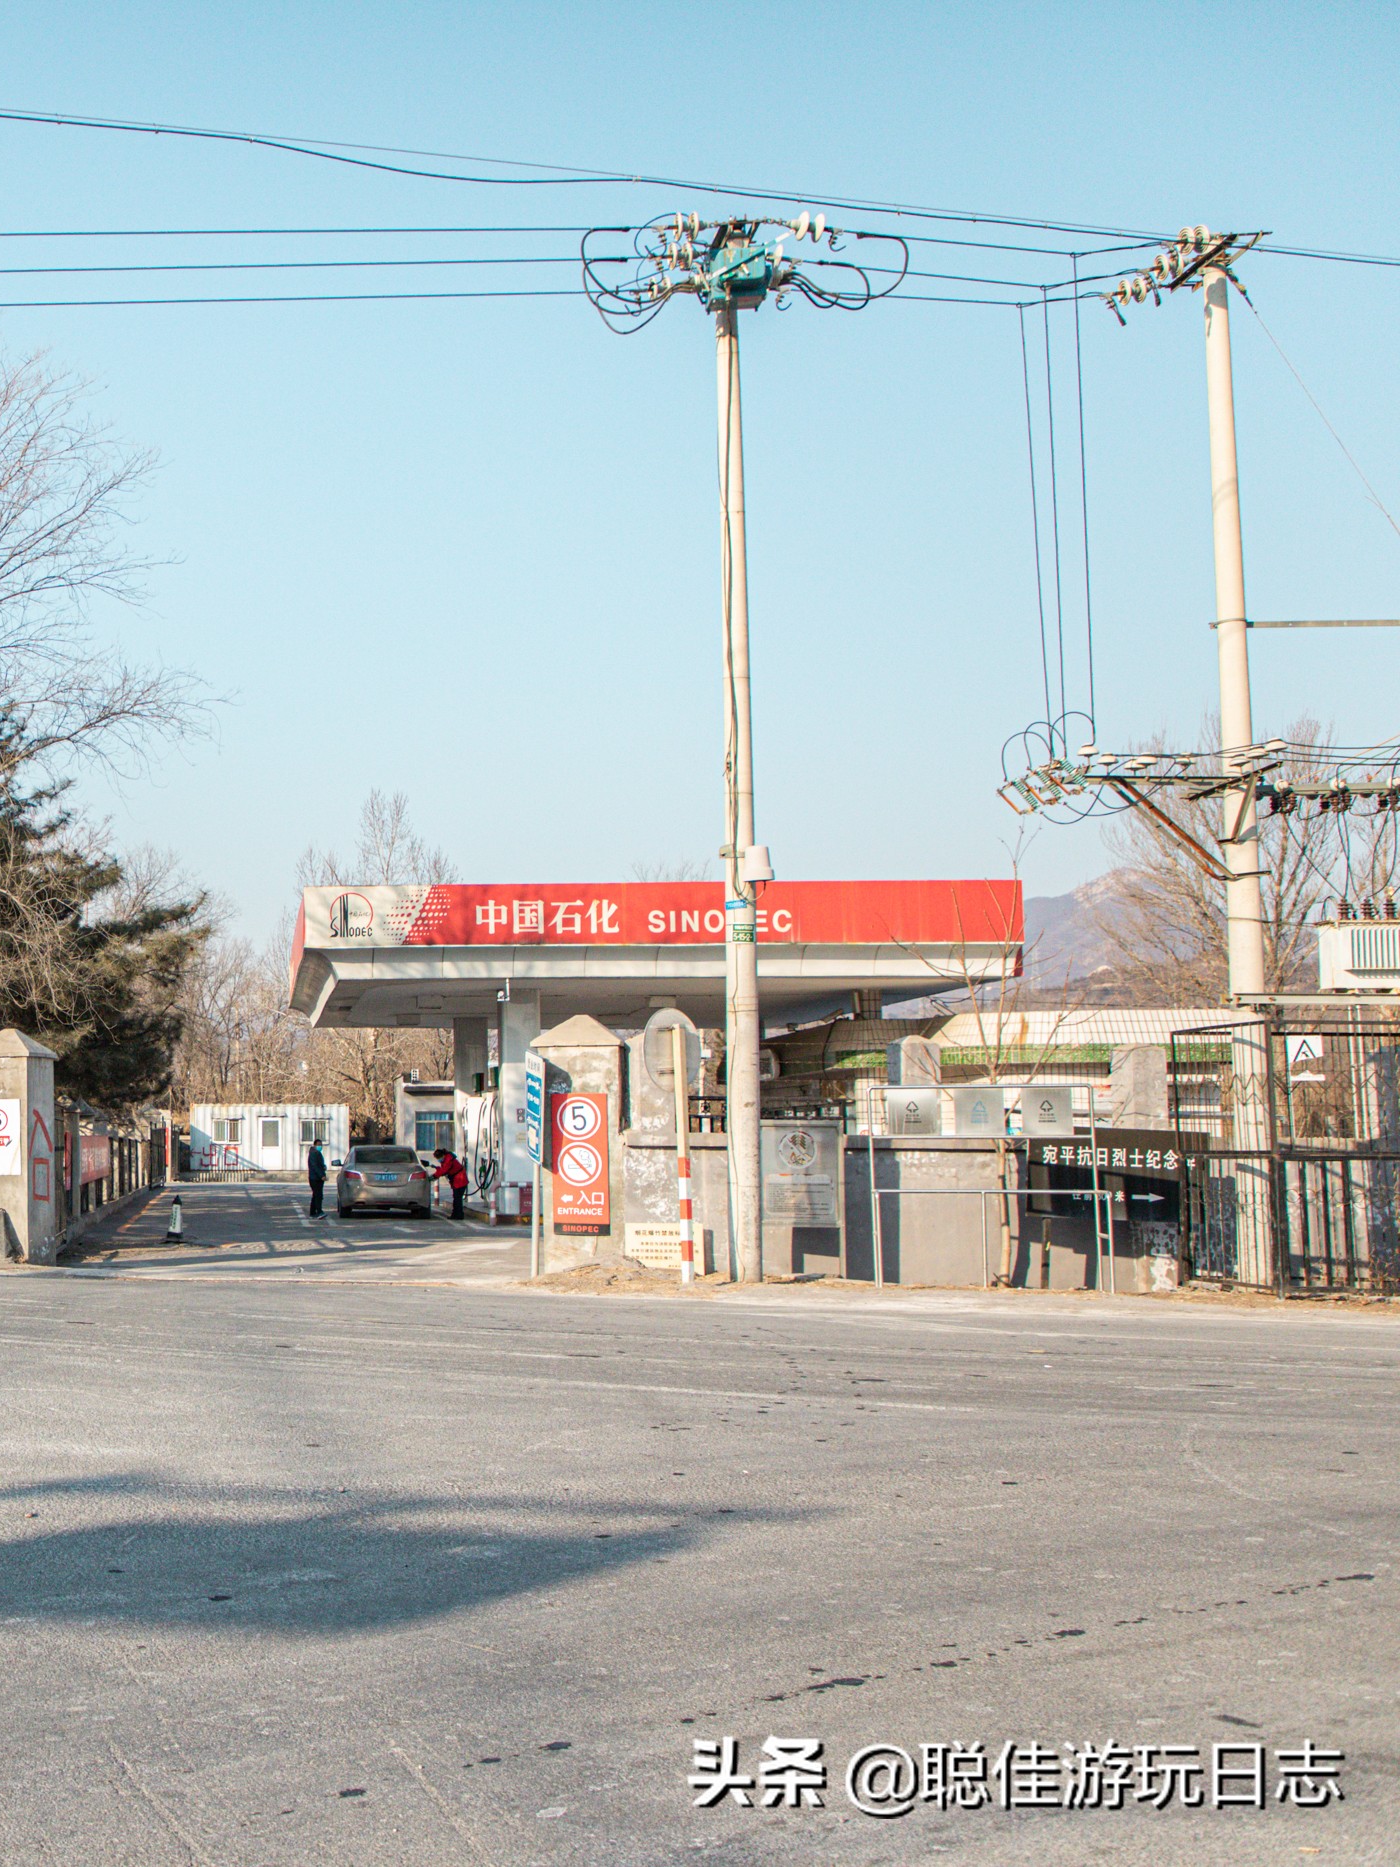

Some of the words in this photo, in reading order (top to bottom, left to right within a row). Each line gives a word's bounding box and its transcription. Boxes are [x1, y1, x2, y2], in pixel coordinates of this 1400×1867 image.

[475, 899, 620, 935] 中国石化
[648, 909, 793, 934] SINOEC
[572, 1106, 587, 1131] 5
[200, 1144, 239, 1168] 出口
[577, 1190, 605, 1205] 入口
[557, 1207, 604, 1216] ENTRANCE
[562, 1224, 599, 1233] SINOPEC
